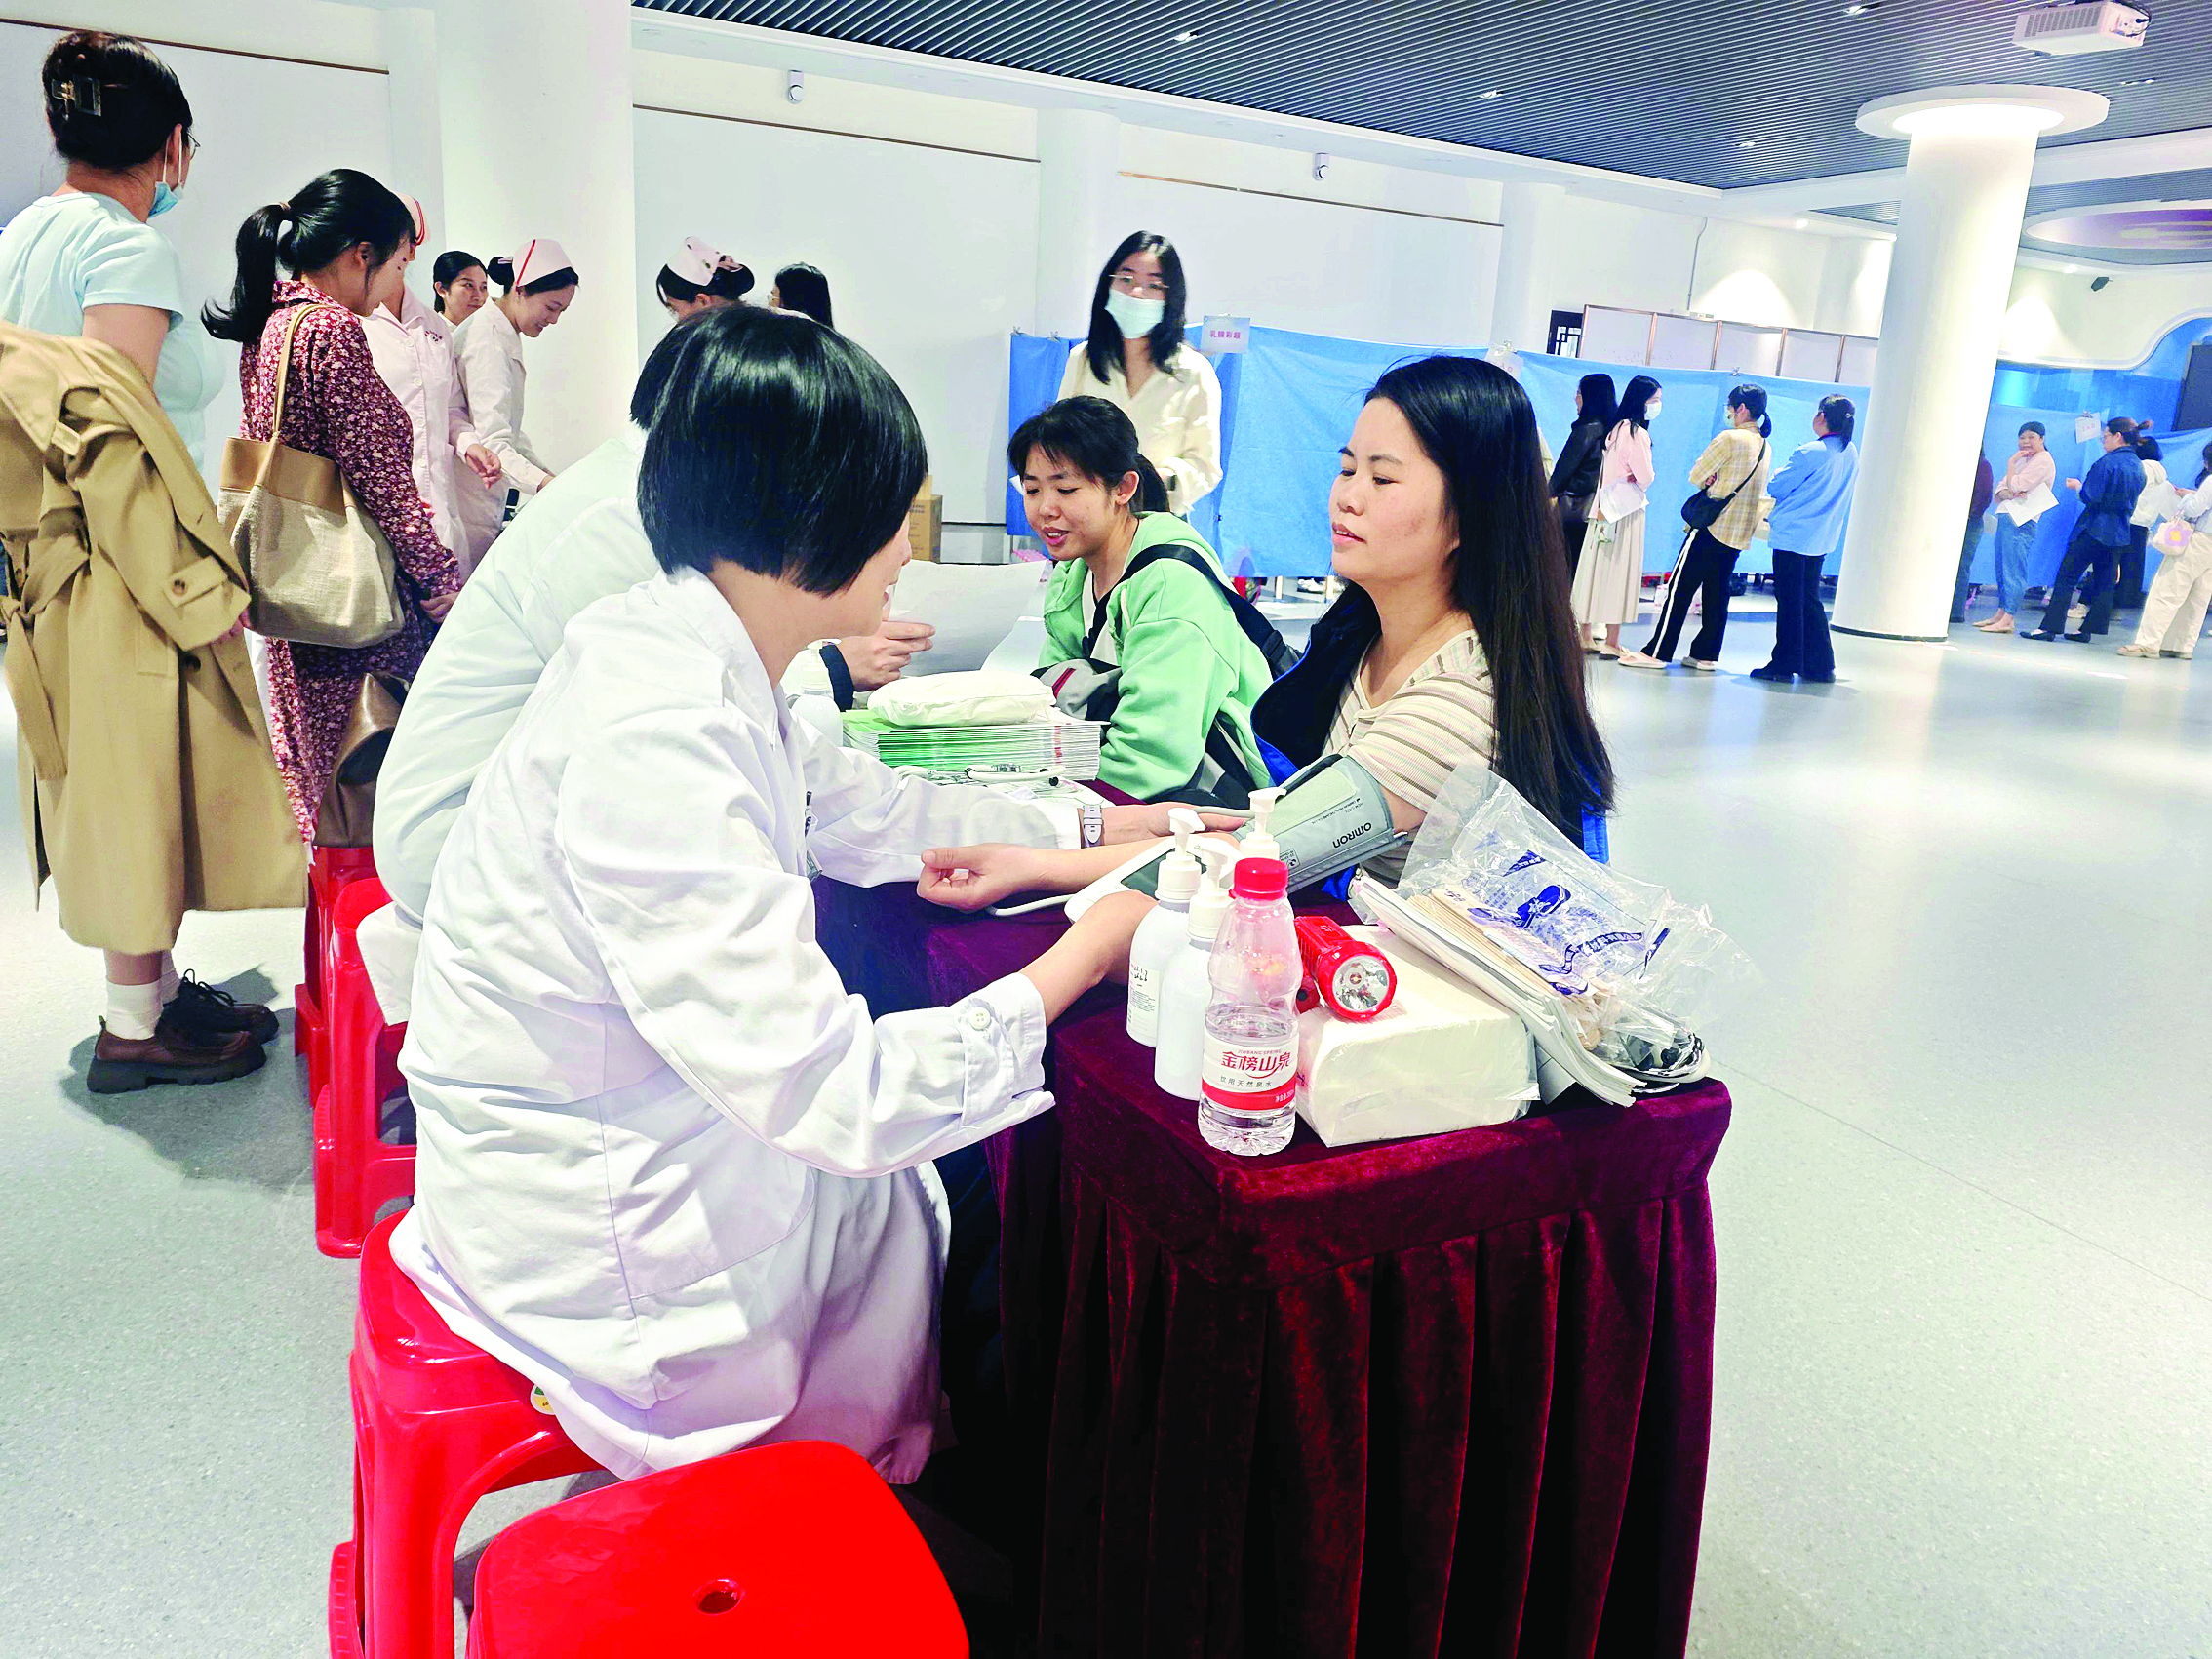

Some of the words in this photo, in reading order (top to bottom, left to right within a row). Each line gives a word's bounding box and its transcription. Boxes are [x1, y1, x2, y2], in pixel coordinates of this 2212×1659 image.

[1332, 822, 1372, 849] OMRON
[1221, 1051, 1291, 1072] 金榜山泉
[1220, 1075, 1272, 1088] 饮用天然泉水
